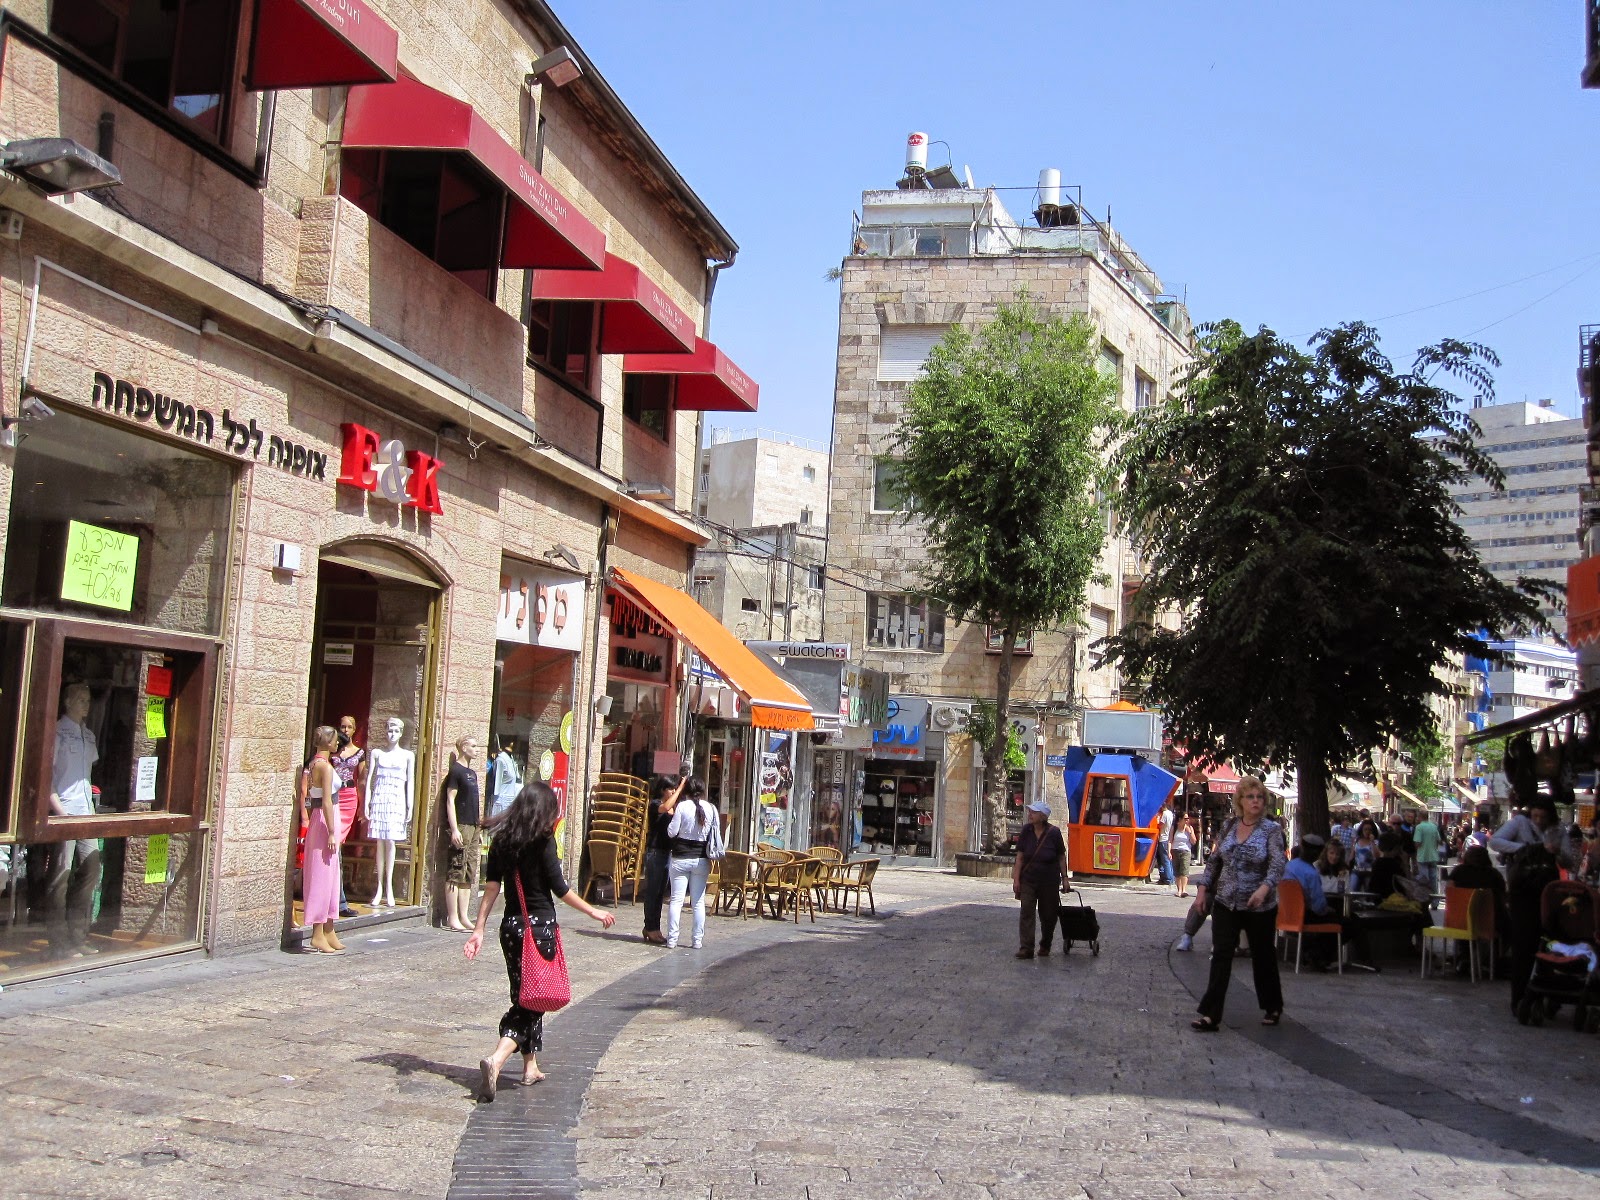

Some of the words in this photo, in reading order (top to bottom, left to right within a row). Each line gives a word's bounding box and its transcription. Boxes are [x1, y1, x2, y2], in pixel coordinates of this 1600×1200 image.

[519, 164, 538, 191] Shuki
[554, 198, 567, 220] Duri
[92, 371, 214, 443] המשפחה
[221, 408, 264, 458] לכל
[269, 434, 328, 481] אופנה
[336, 423, 445, 516] E&K
[80, 527, 126, 553] מבצע
[778, 644, 834, 658] swatch
